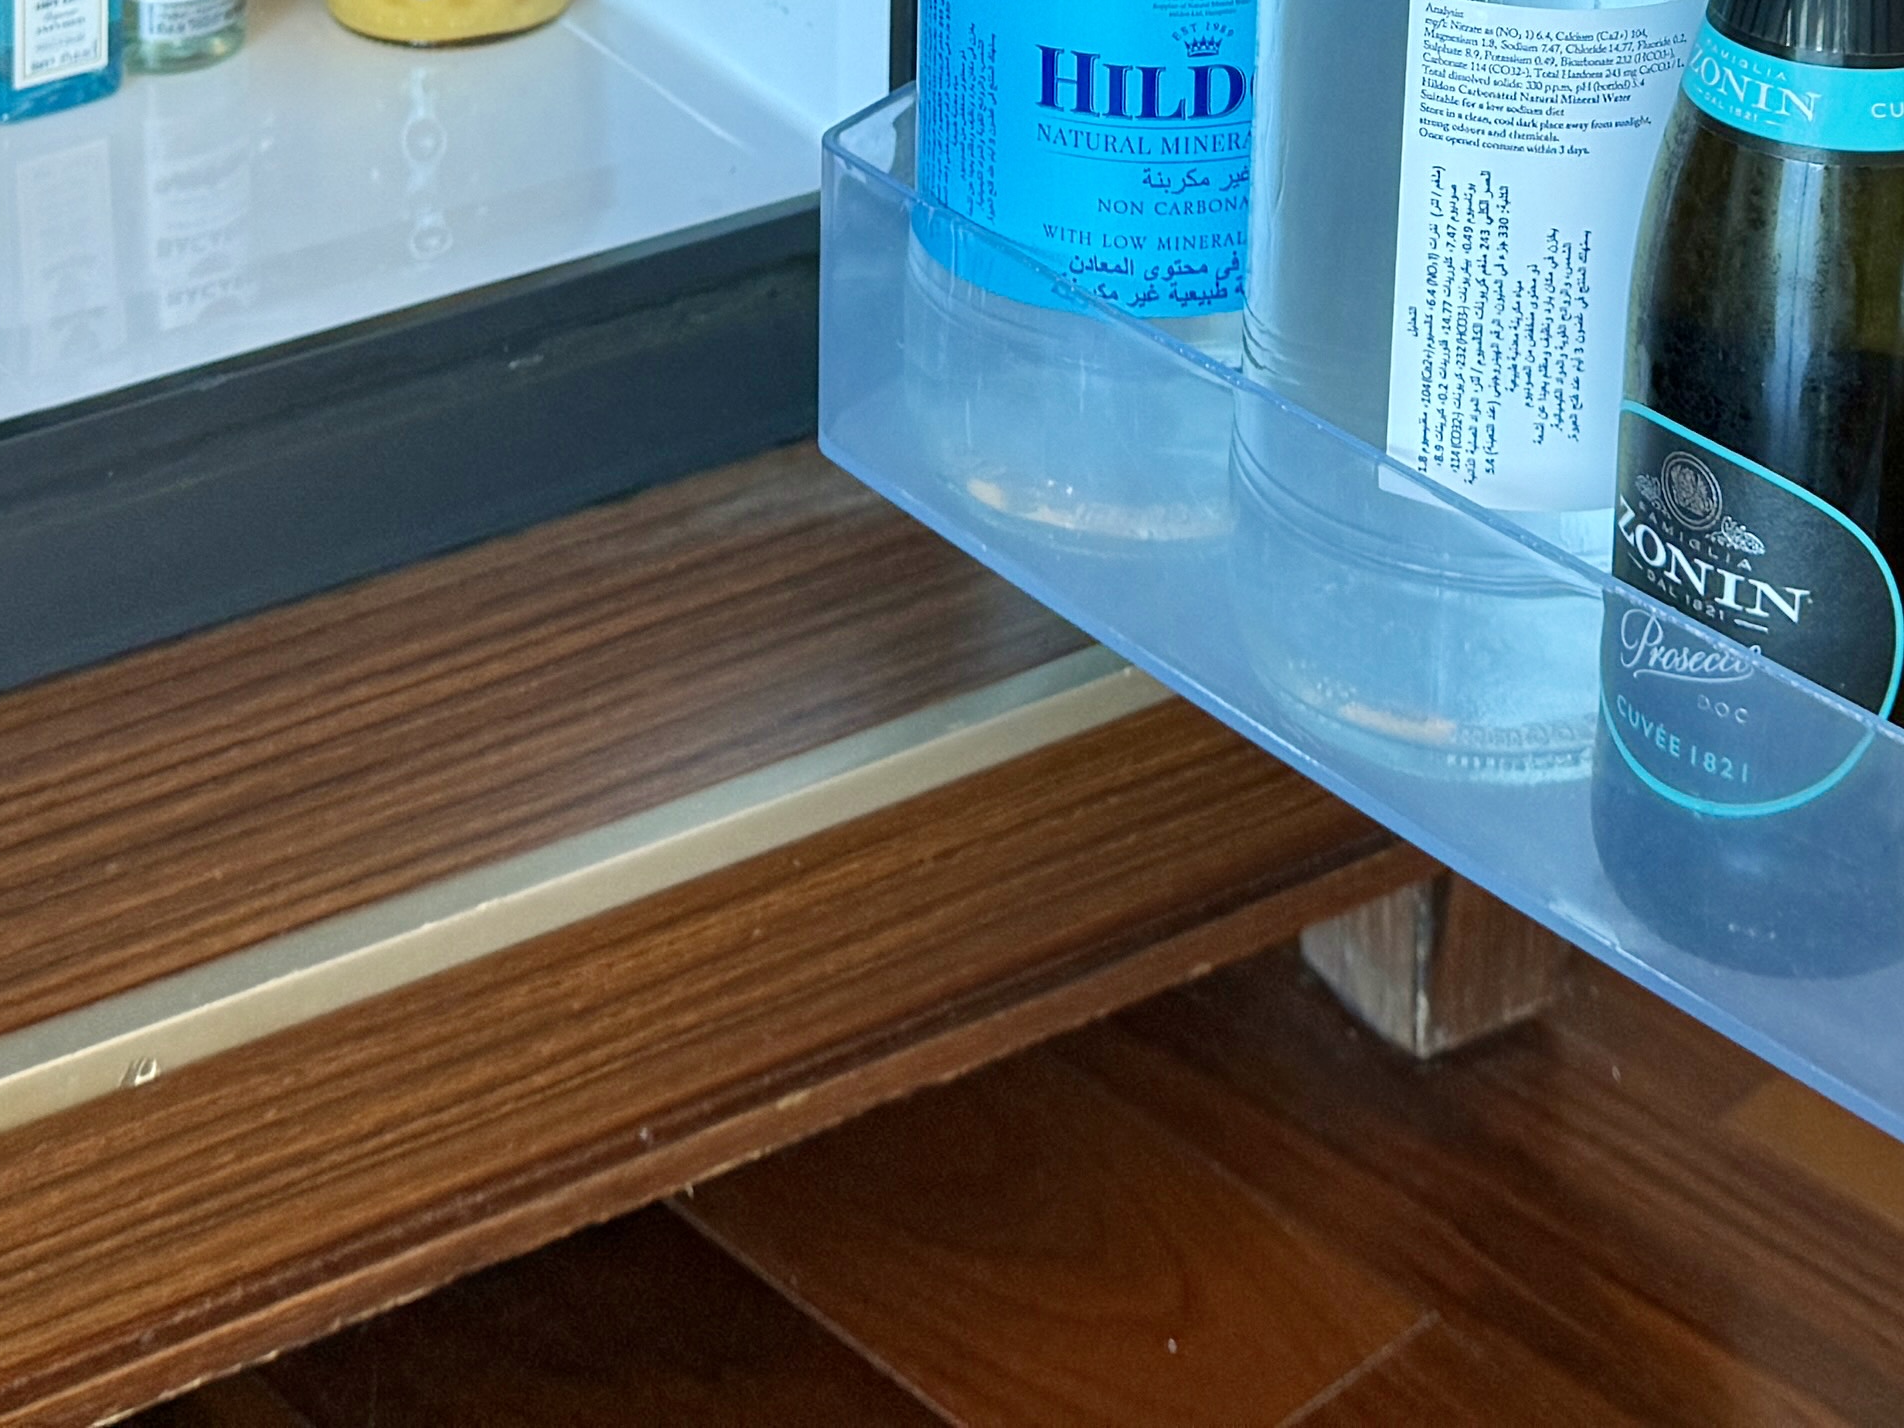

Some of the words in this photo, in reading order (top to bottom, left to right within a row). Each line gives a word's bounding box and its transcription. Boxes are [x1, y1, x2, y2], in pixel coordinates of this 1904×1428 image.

[1035, 43, 1256, 121] HILD
[1422, 76, 1455, 92] Hildon
[1459, 84, 1517, 101] Carbonated
[1520, 92, 1558, 104] Natural
[1561, 94, 1599, 104] Mineral
[1603, 93, 1631, 103] Water
[1688, 49, 1822, 123] ZONIN
[1420, 102, 1443, 114] Store
[1446, 109, 1455, 118] in
[1465, 113, 1492, 125] clean,
[1494, 116, 1514, 126] cool
[1517, 117, 1537, 128] dark
[1540, 120, 1564, 131] place
[1566, 122, 1588, 132] away
[1591, 119, 1612, 129] from
[1462, 98, 1476, 109] for
[1545, 106, 1565, 116] diet
[1037, 122, 1151, 155] NATURAL
[1419, 117, 1449, 131] strong
[1452, 124, 1485, 135] odours
[1488, 129, 1506, 138] and
[1419, 128, 1443, 140] Once
[1446, 134, 1480, 147] opened
[1482, 142, 1524, 152] consume
[1527, 144, 1557, 154] within
[1558, 145, 1564, 154] 3
[1142, 168, 1210, 194] مكربنة
[1098, 197, 1145, 216] NON
[1043, 223, 1092, 247] WITH
[1102, 232, 1147, 250] LOW
[1157, 229, 1246, 251] MINERAL
[1638, 499, 1752, 572] FAMIGLIA
[1619, 494, 1812, 624] ZONIN
[1647, 569, 1678, 600] DAL
[1684, 596, 1726, 622] 1821
[1697, 694, 1749, 724] DOC
[1616, 694, 1681, 759] CUVÉE
[1690, 743, 1749, 784] 1821
